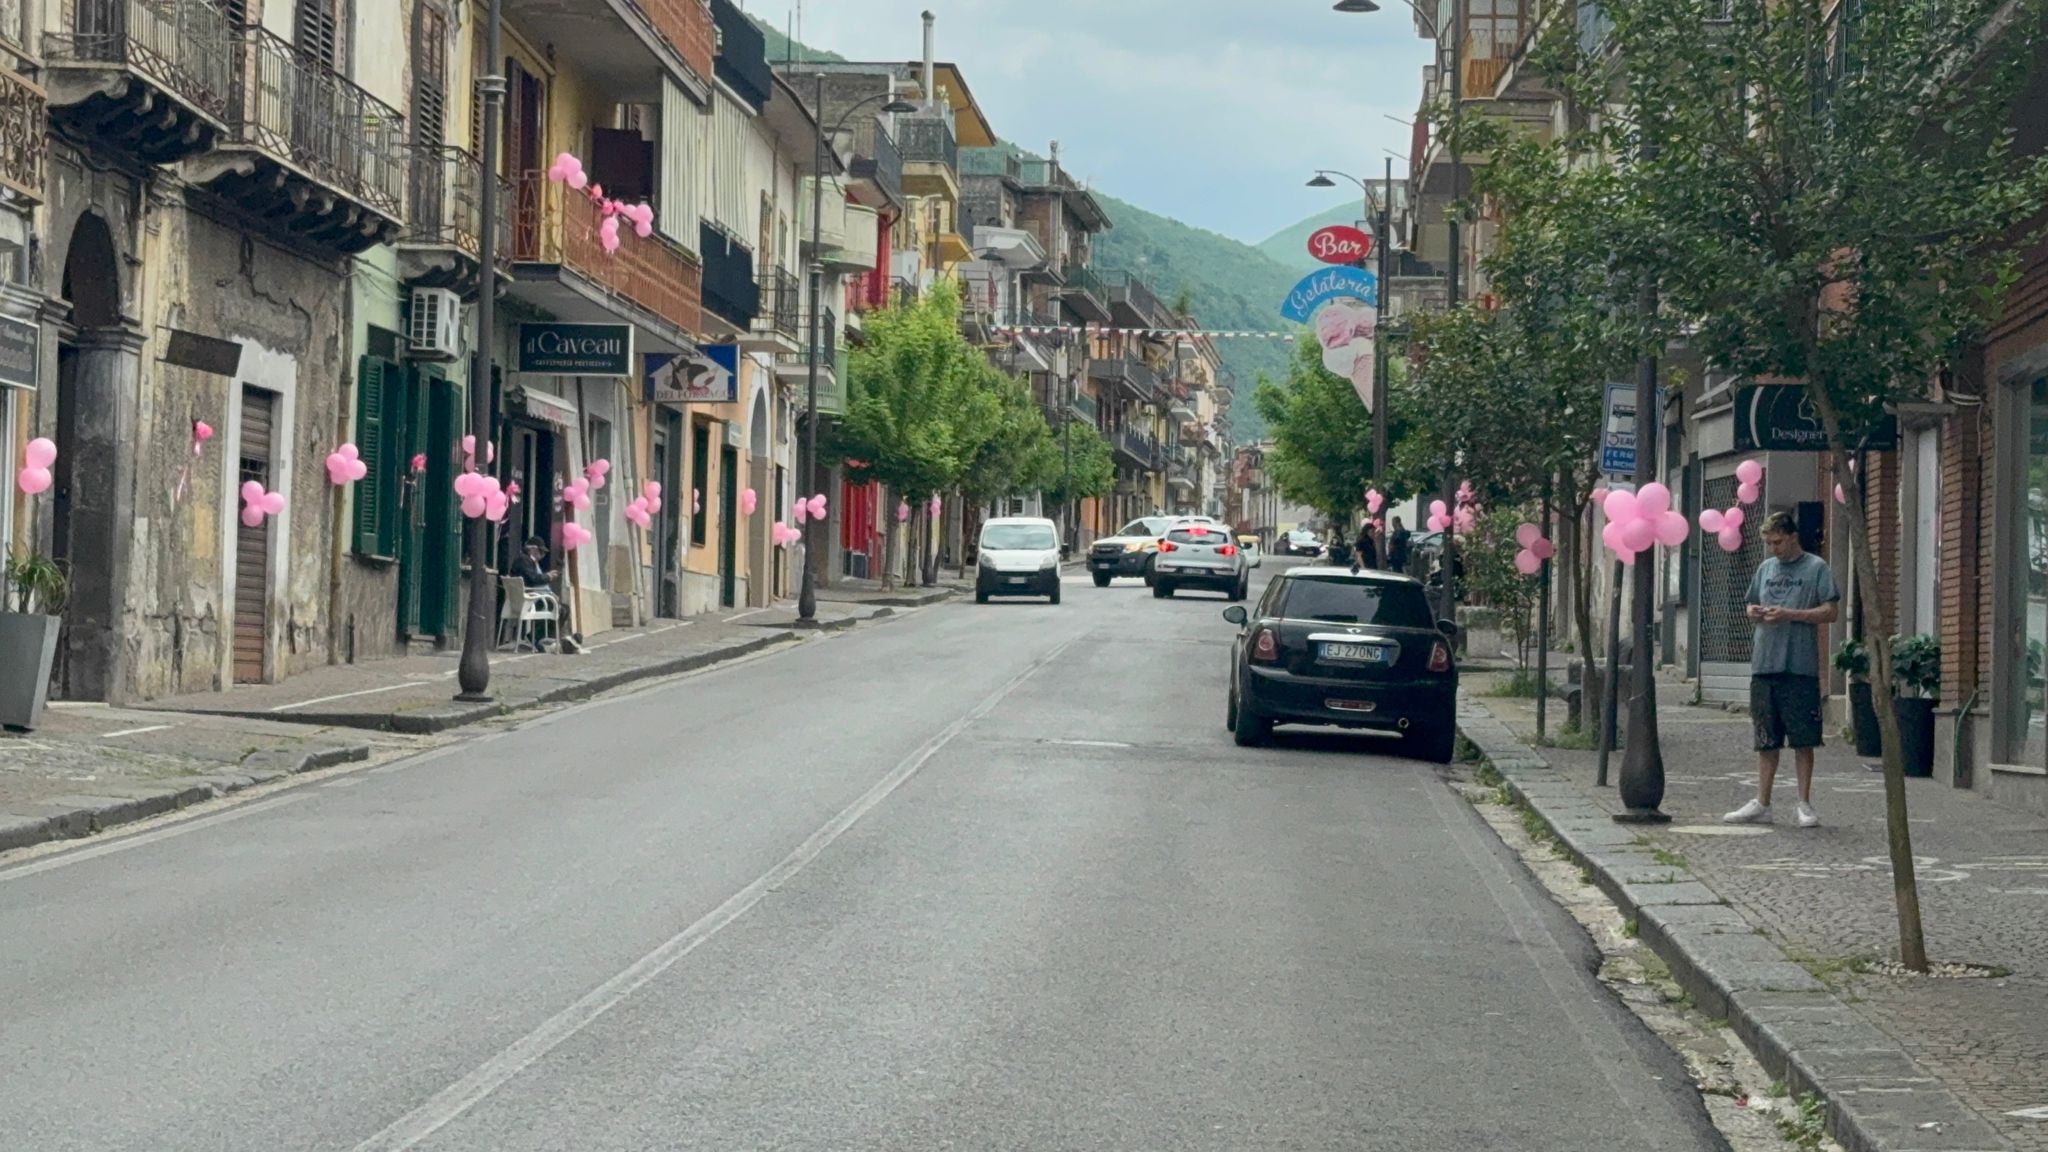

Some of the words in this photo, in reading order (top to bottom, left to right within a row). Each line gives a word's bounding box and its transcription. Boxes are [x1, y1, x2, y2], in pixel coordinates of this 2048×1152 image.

[1314, 231, 1362, 258] Bar
[1290, 270, 1371, 318] Gelateria
[538, 331, 620, 355] Caveau
[1771, 426, 1823, 443] Designer
